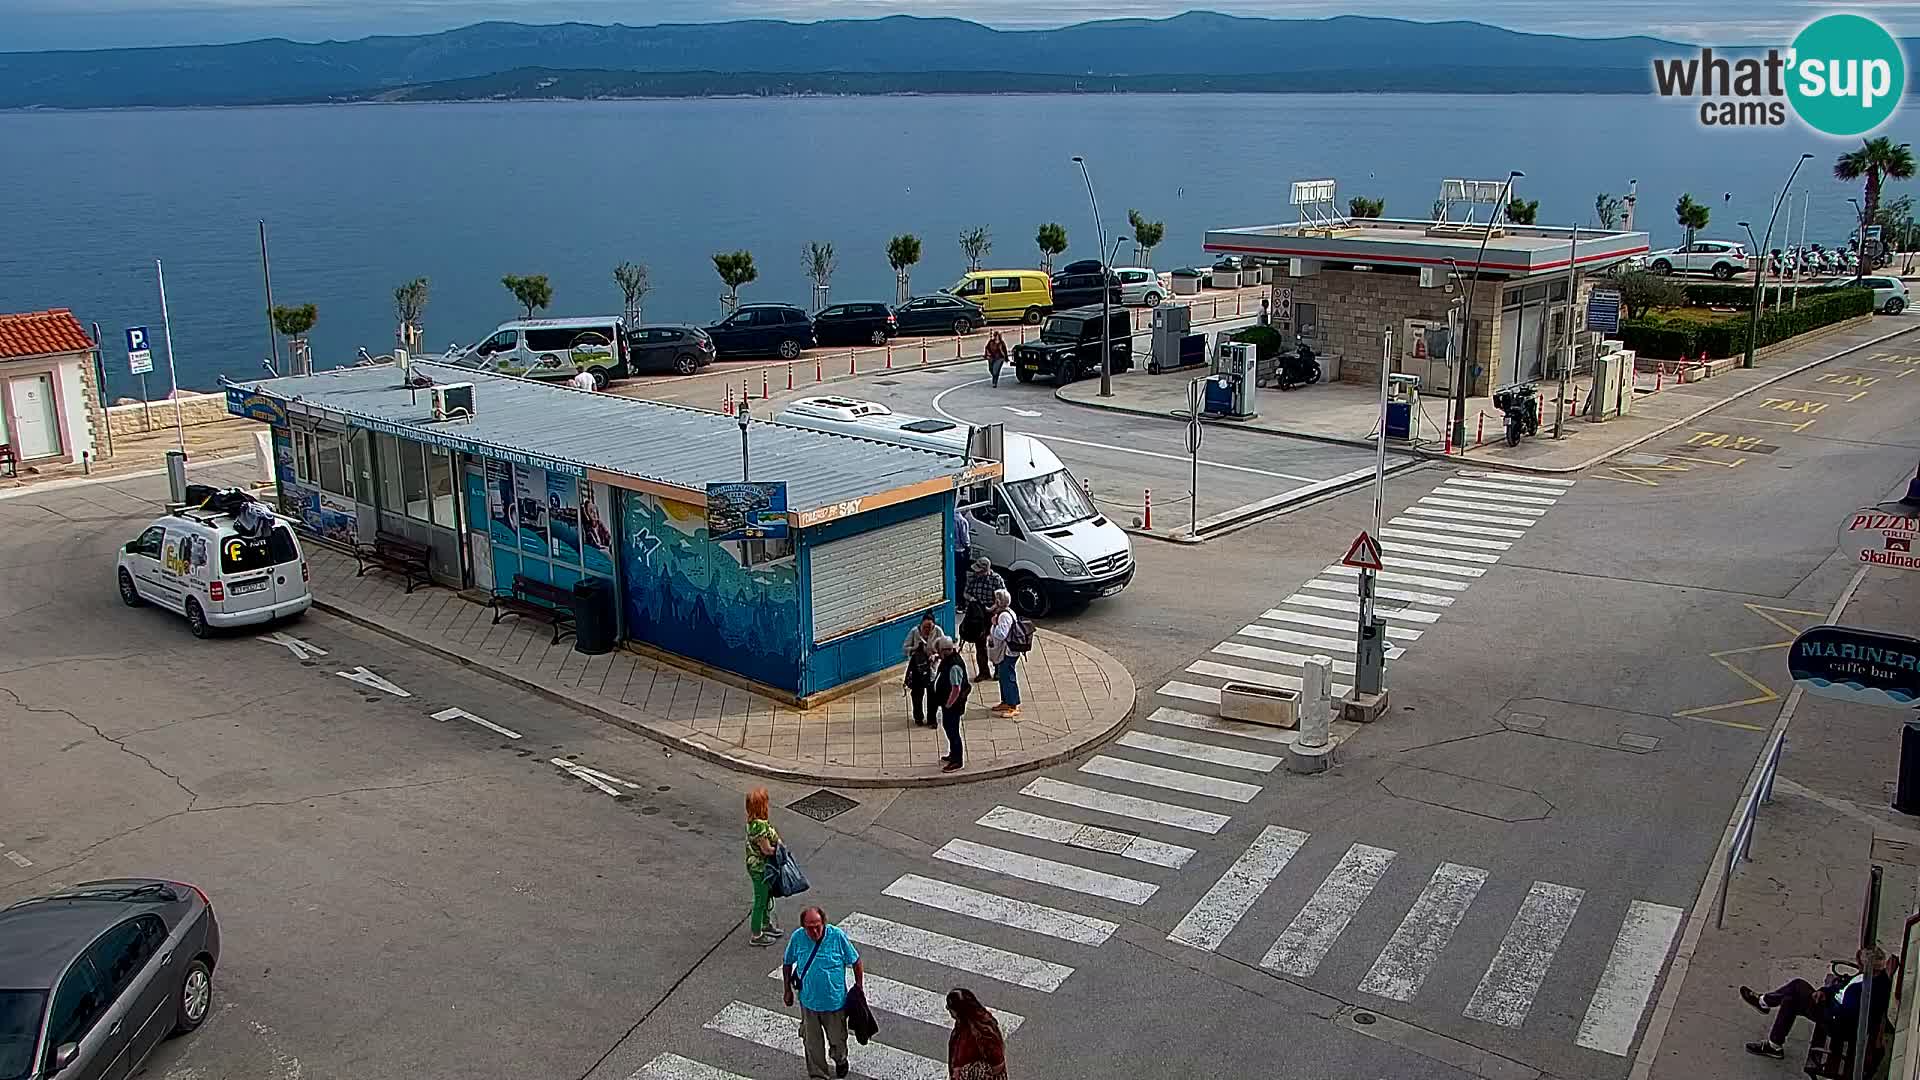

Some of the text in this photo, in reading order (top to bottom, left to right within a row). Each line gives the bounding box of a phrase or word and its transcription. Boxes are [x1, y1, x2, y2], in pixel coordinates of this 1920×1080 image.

[130, 330, 144, 349] P
[1815, 373, 1881, 387] TAXI
[1759, 398, 1830, 414] TAXI
[1687, 431, 1763, 450] TAXI
[397, 428, 437, 443] AUTOBUSNA
[437, 436, 469, 451] POSTAJA
[479, 446, 494, 457] BUS
[494, 449, 527, 464] STATION
[529, 456, 555, 471] TICKET
[556, 463, 583, 477] OFFICE
[1848, 514, 1920, 533] PIZZE
[1881, 529, 1920, 540] GRILL
[1801, 642, 1920, 672] MARINER
[1829, 662, 1897, 679] caffe bar
